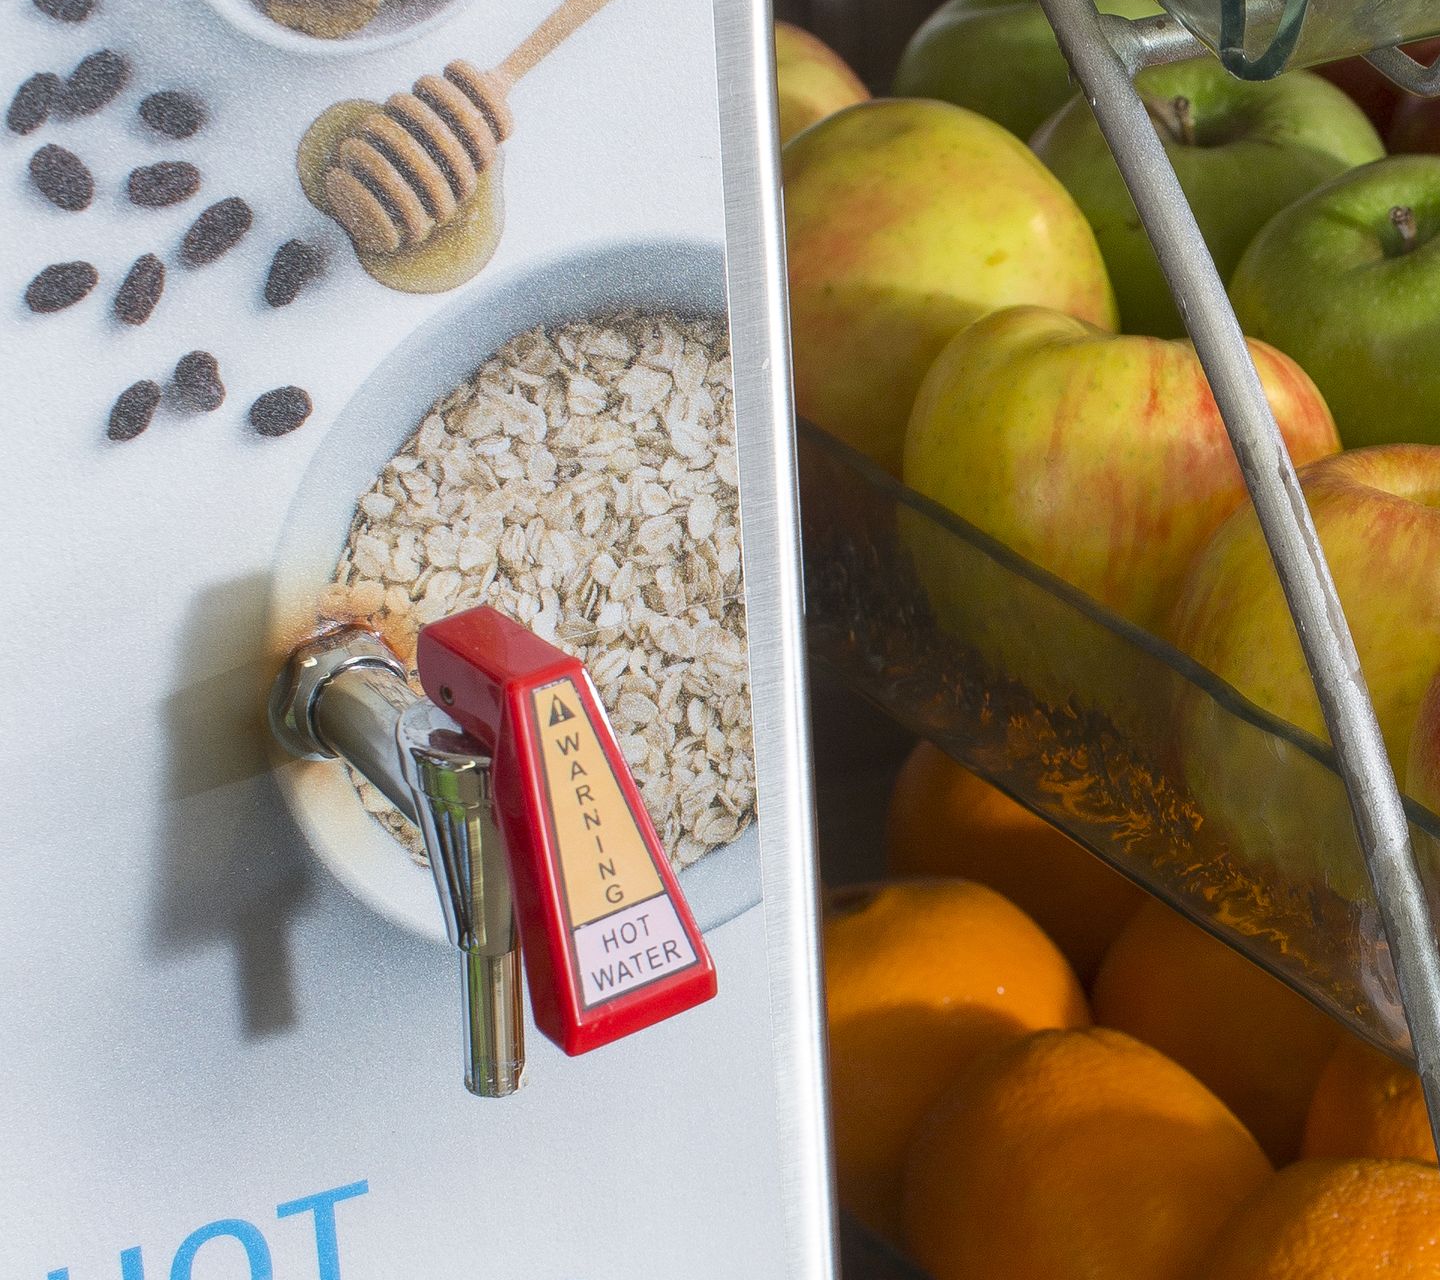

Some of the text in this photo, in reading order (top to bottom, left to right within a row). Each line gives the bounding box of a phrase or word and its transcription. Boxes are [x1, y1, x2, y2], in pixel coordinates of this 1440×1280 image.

[556, 732, 625, 904] WARNING
[602, 914, 651, 953] HOT
[591, 939, 683, 992] WATER
